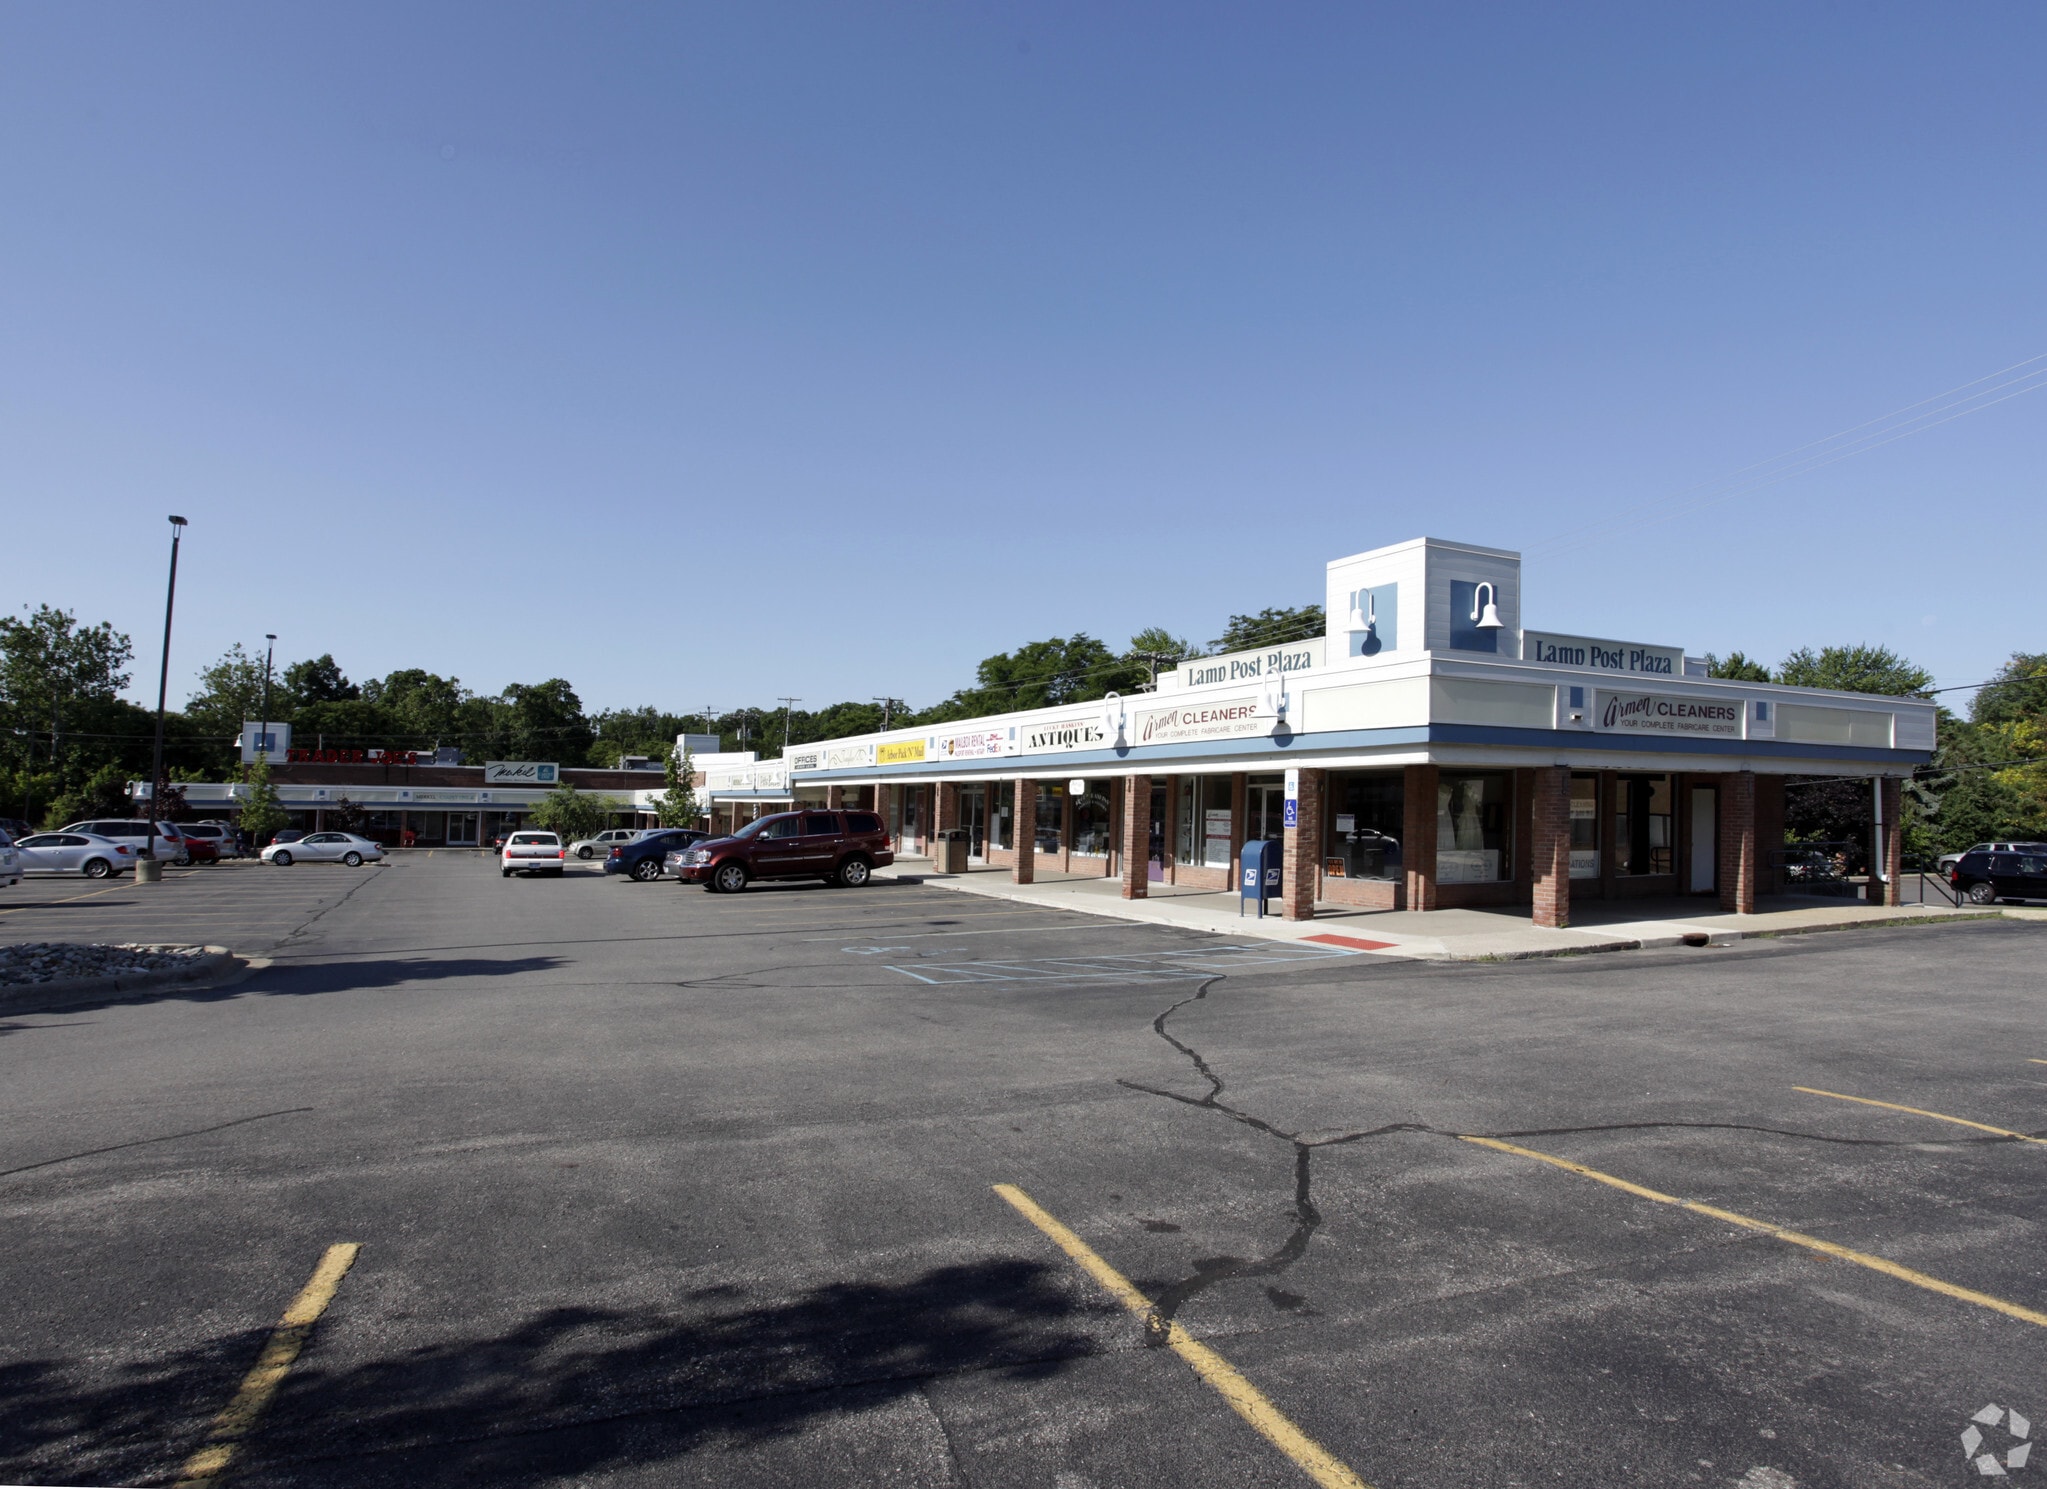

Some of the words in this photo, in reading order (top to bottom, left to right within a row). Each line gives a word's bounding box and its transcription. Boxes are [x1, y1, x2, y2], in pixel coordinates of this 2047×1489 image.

[1230, 656, 1263, 680] Post
[1267, 650, 1312, 674] Plaza
[1590, 646, 1625, 670] Post
[1629, 650, 1672, 674] Plaza
[1182, 705, 1257, 725] CLEANERS
[1657, 702, 1736, 721] CLEANERS
[1155, 730, 1169, 739] YOUR
[1170, 728, 1199, 738] COMPLETE
[1201, 725, 1231, 735] FABRICARE
[1234, 723, 1258, 732] CENTER
[1620, 719, 1639, 728] YOUR
[1641, 720, 1675, 730] COMPLETE
[1677, 722, 1710, 732] FABRICARE
[1712, 724, 1736, 733] CENTER
[1028, 726, 1104, 748] ANTIQUES
[286, 748, 363, 764] TRADER
[986, 743, 1001, 754] FedEx
[794, 755, 817, 764] OFFICES
